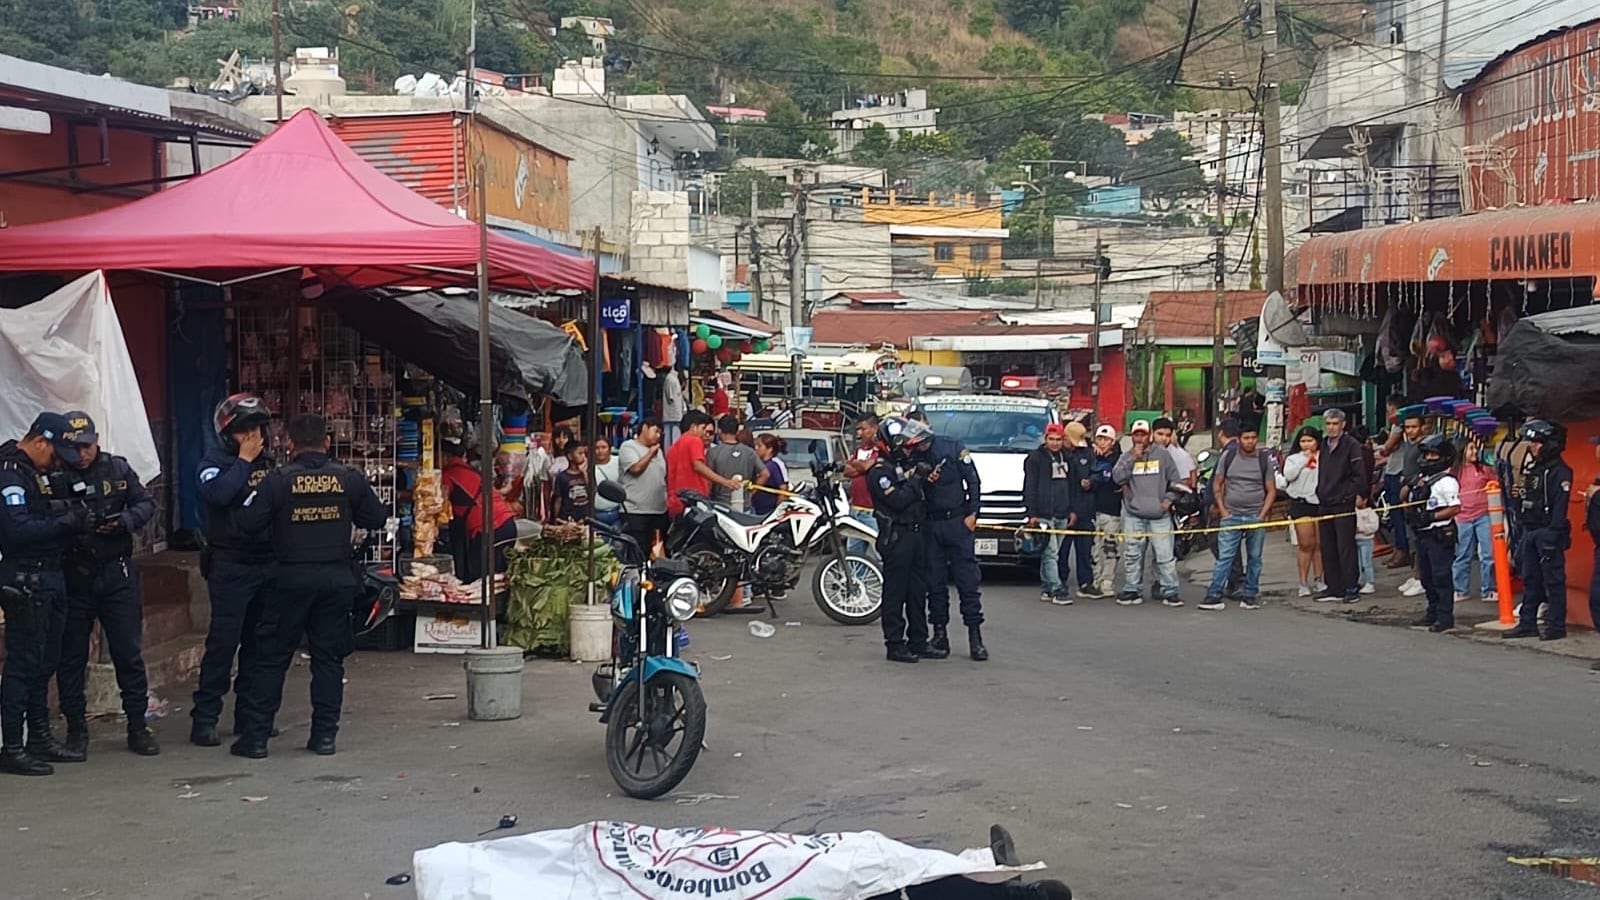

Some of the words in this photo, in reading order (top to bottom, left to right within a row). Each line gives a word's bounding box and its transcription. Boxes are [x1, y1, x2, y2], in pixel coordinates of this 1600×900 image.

[1491, 232, 1571, 272] CANANEO
[296, 475, 338, 485] POLICIA
[292, 484, 344, 493] MUNICIPAL
[293, 505, 338, 514] MUNICIPALIDAD
[644, 861, 771, 897] Bomberos
